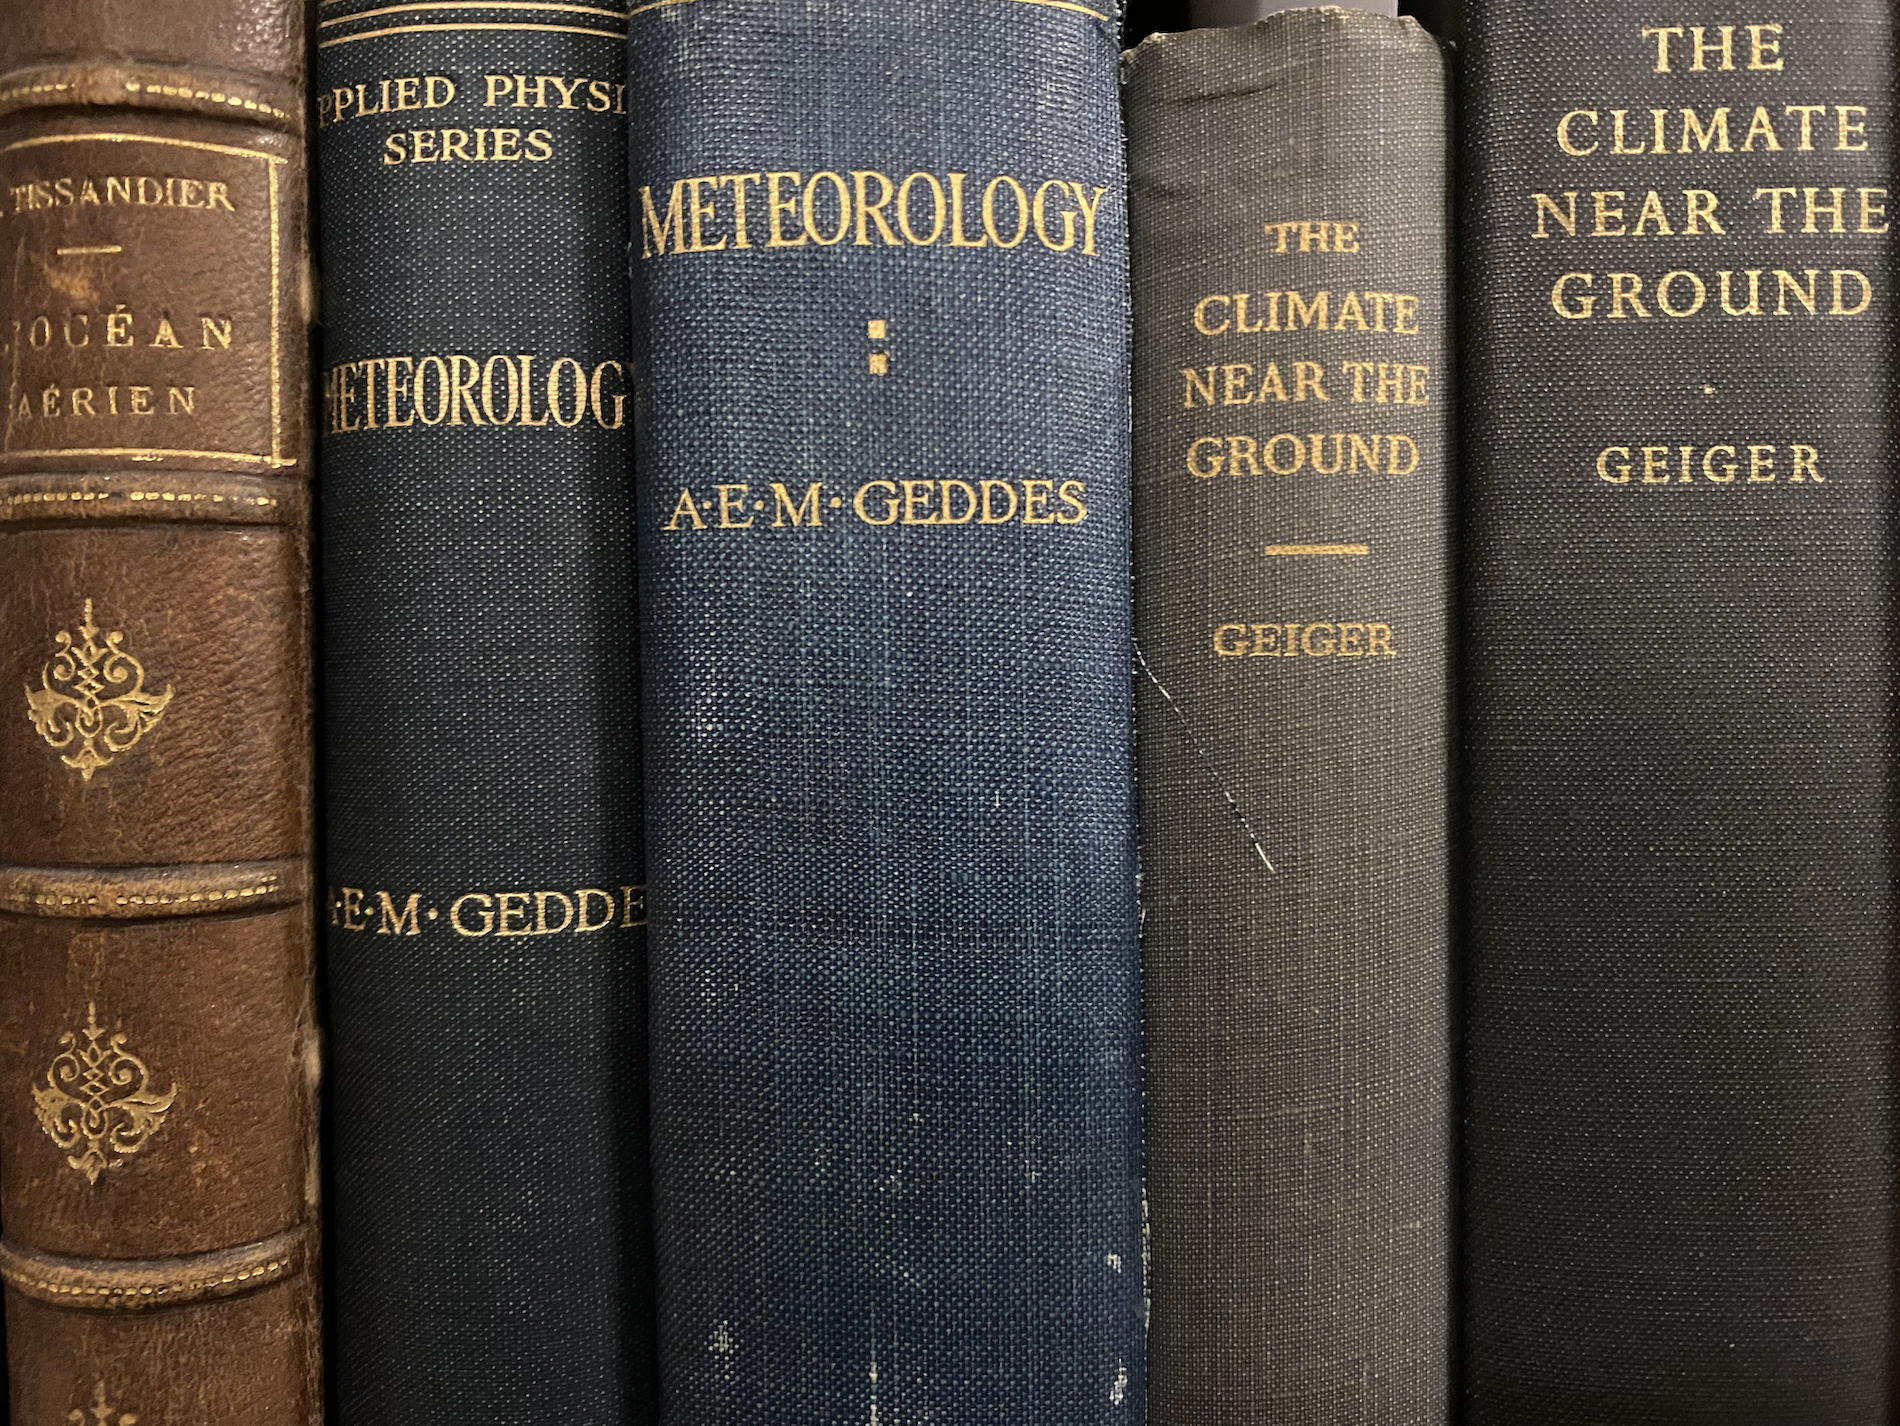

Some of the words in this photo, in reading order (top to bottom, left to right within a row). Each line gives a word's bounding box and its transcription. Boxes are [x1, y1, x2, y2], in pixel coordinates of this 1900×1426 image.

[1642, 22, 1784, 73] THE
[383, 127, 553, 166] SERIES
[1556, 104, 1868, 156] CLIMATE
[638, 170, 1108, 260] METEOROLOGY
[1531, 188, 1726, 239] NEAR
[1752, 186, 1890, 235] THE
[1264, 220, 1360, 254] THE
[1193, 290, 1420, 336] CLIMATE
[1551, 269, 1872, 320] GROUND
[3, 304, 233, 351] 'OCÉAN
[1180, 360, 1330, 408] NEAR
[1341, 361, 1430, 405] THE
[1186, 432, 1420, 479] GROUND
[1596, 444, 1826, 485] GEIGER
[1213, 622, 1397, 658] GEIGER
